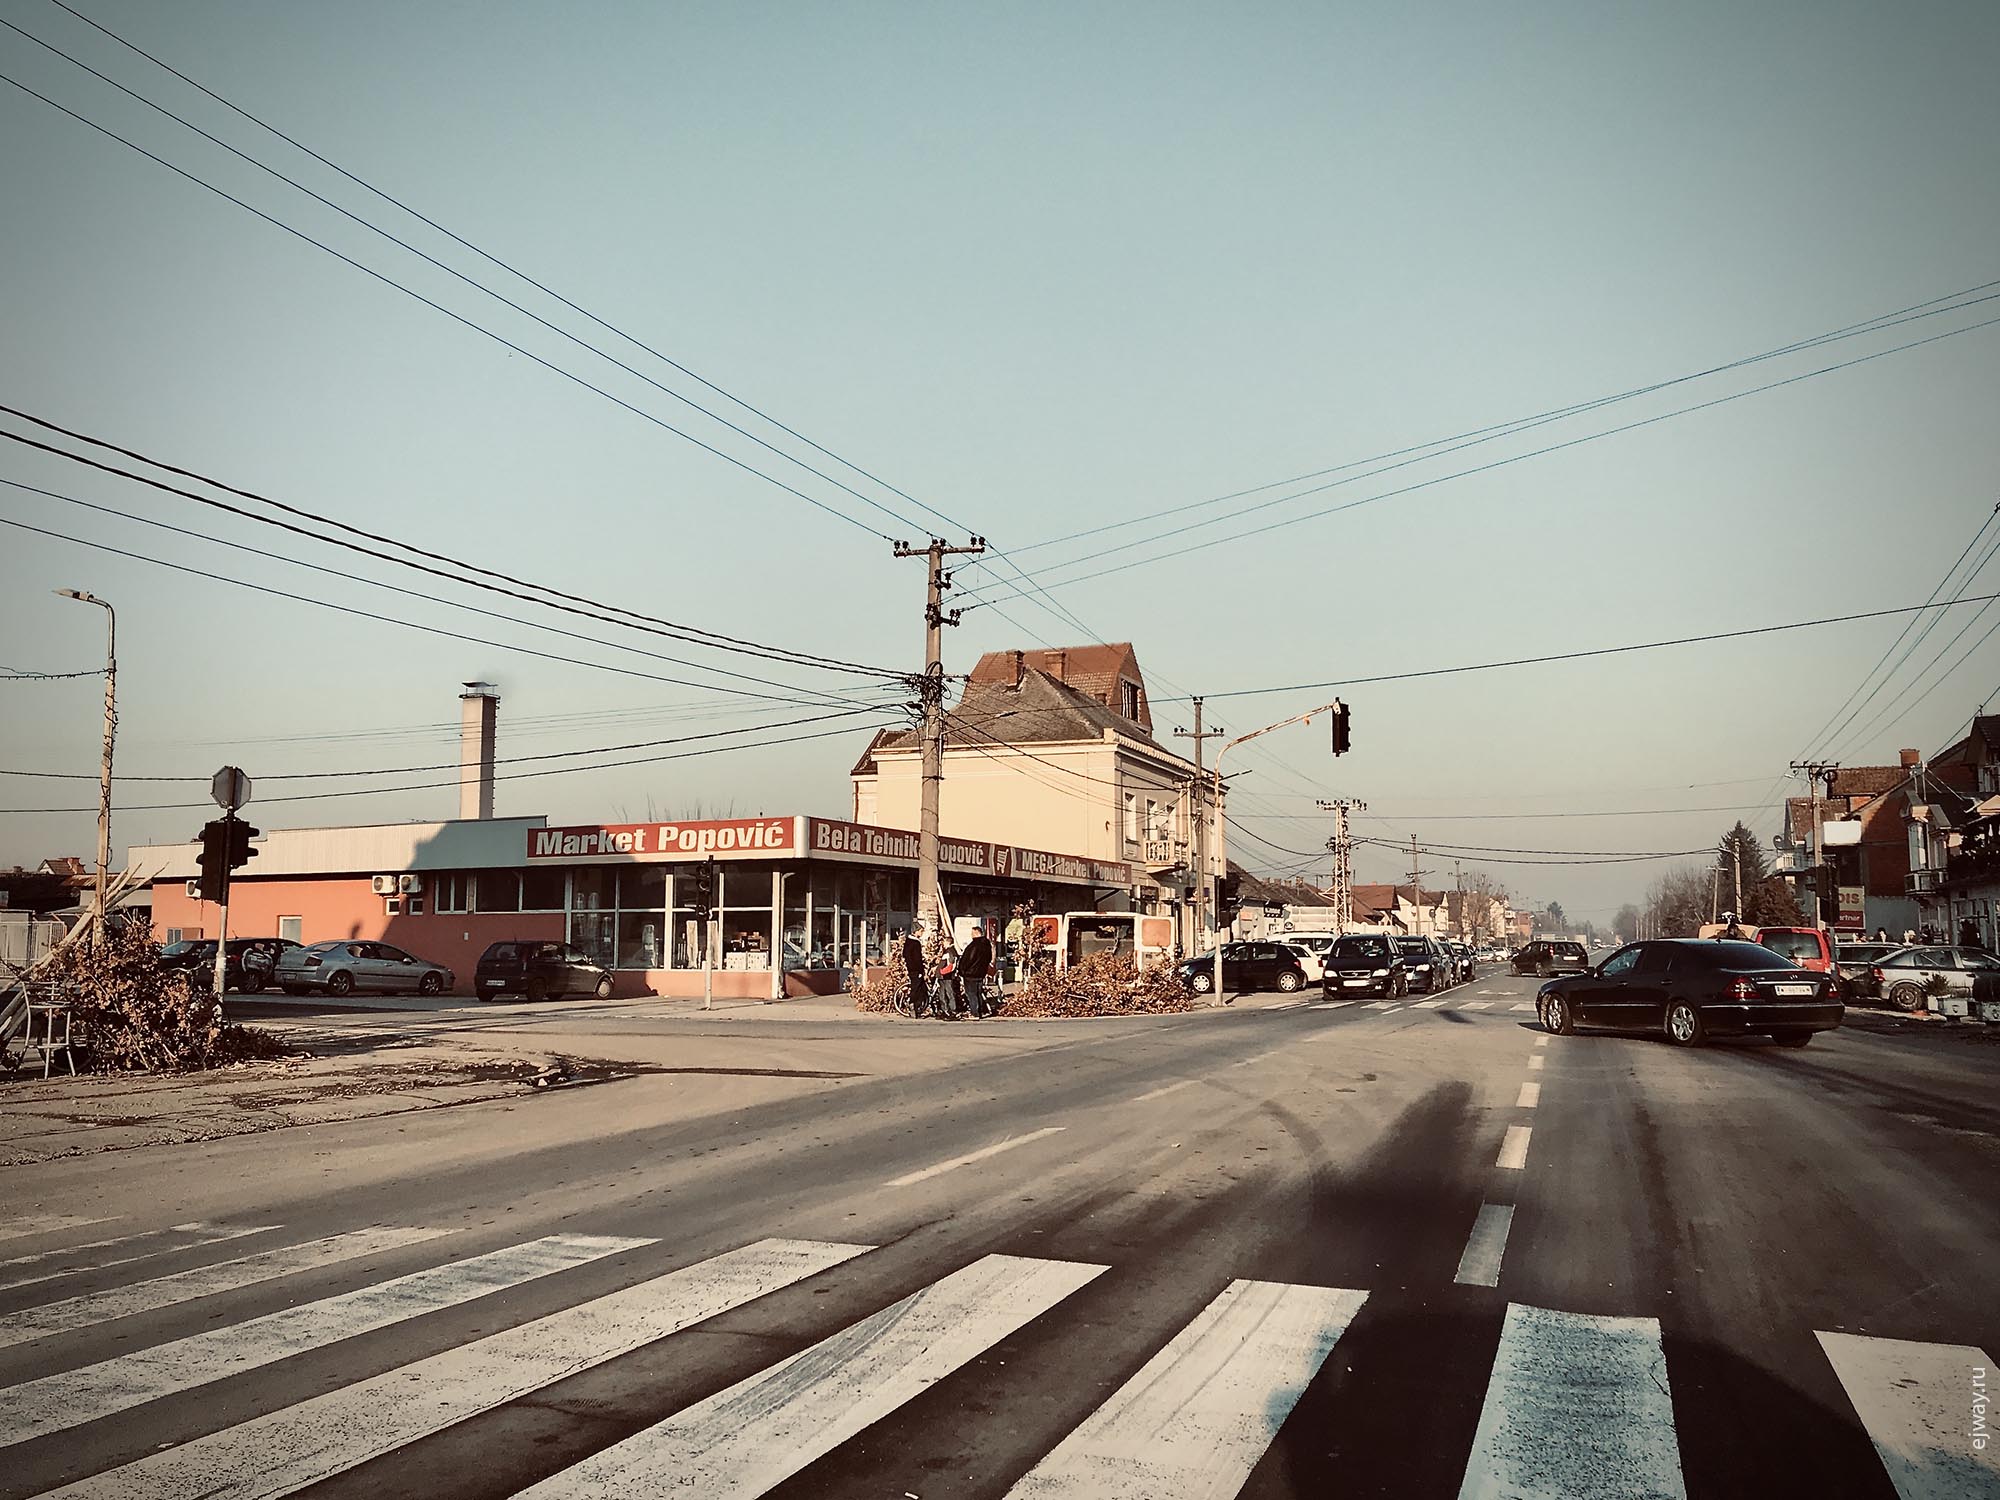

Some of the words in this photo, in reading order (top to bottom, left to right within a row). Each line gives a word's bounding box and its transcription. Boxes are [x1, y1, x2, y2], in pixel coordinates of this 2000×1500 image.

[536, 828, 646, 855] Market
[658, 822, 784, 852] Popović
[817, 823, 861, 852] Bela
[864, 829, 919, 858] Tehnik
[938, 840, 983, 865] opović
[1022, 851, 1053, 873] MEGA
[1094, 863, 1126, 882] Popović
